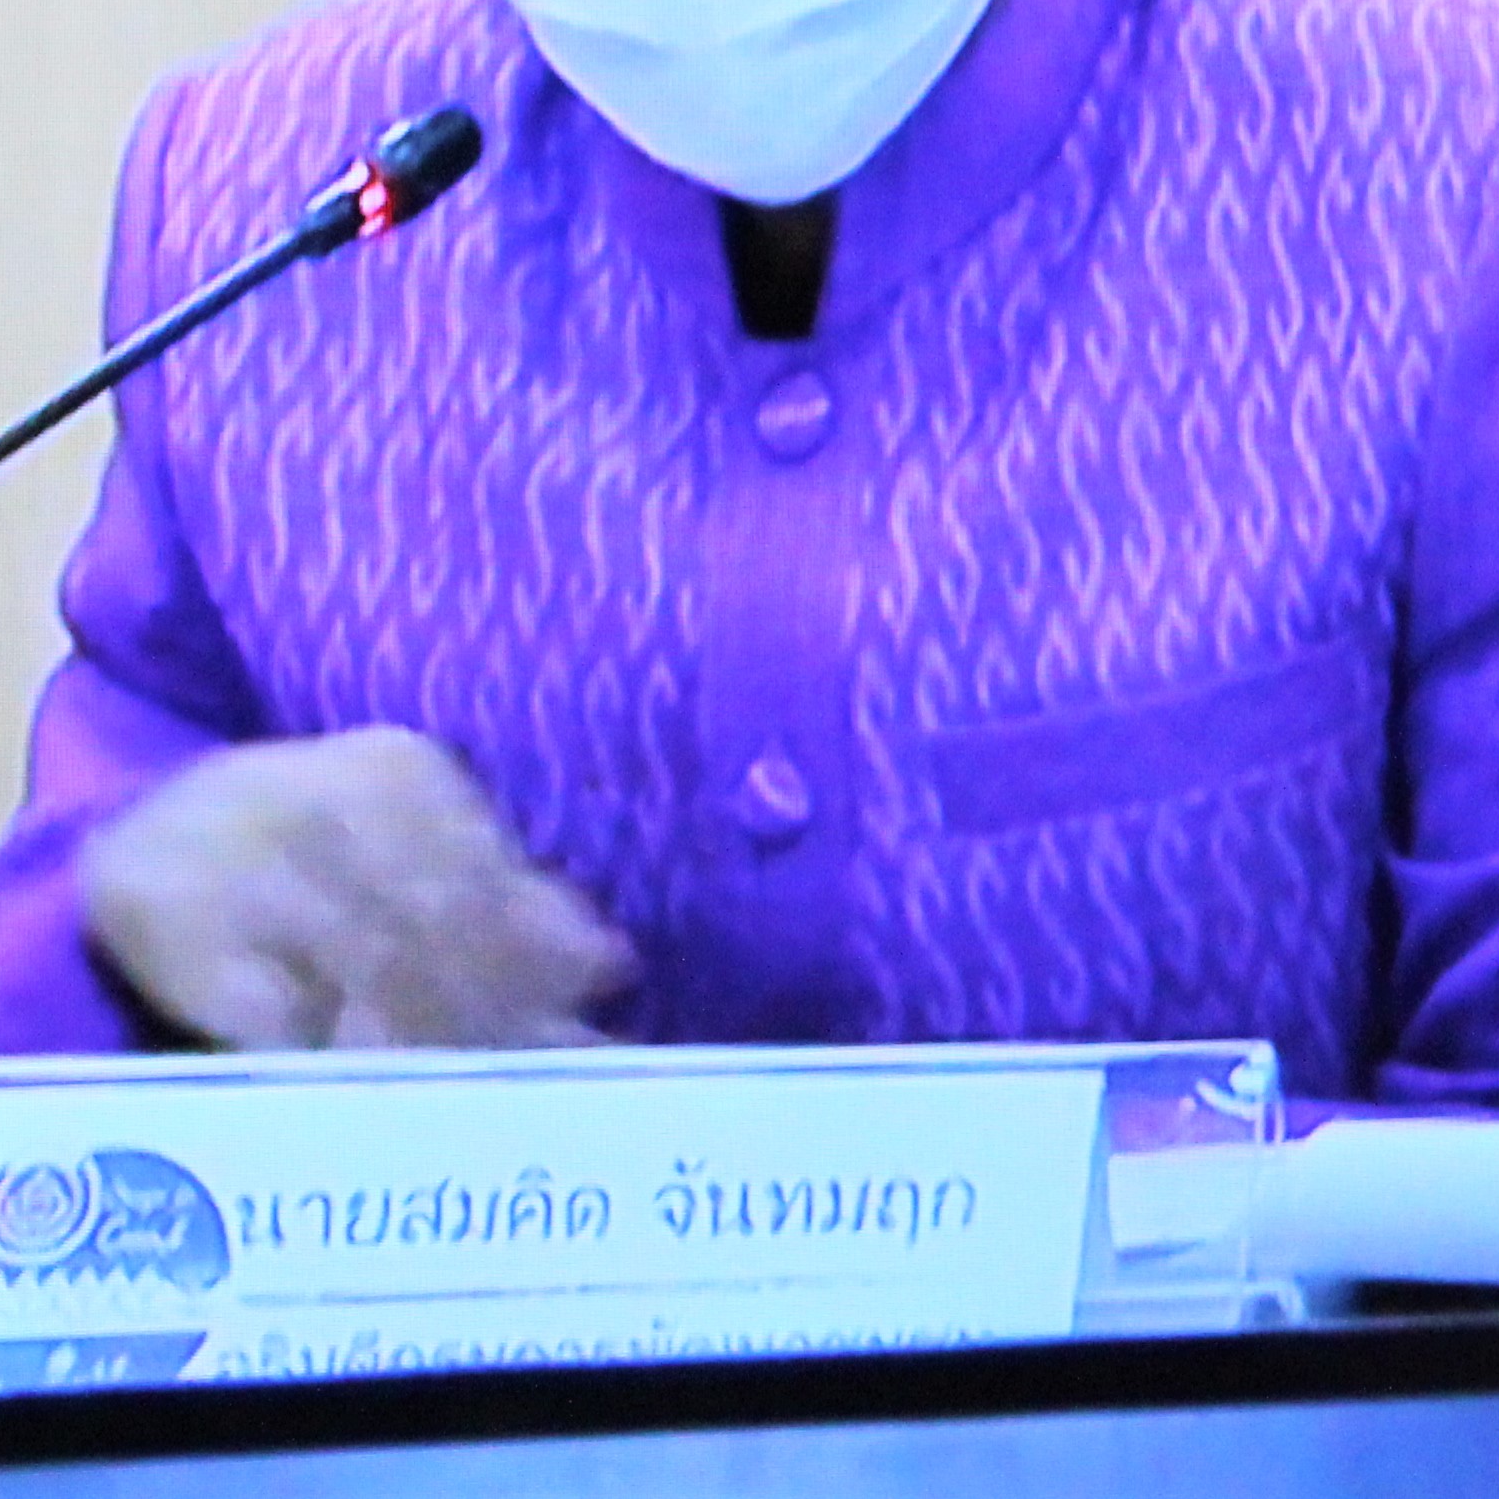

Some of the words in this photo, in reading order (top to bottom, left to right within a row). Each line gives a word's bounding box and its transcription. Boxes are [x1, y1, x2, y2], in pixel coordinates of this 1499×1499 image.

[235, 1164, 610, 1249] นายสมคิด
[652, 1155, 978, 1250] จันทมฤก
